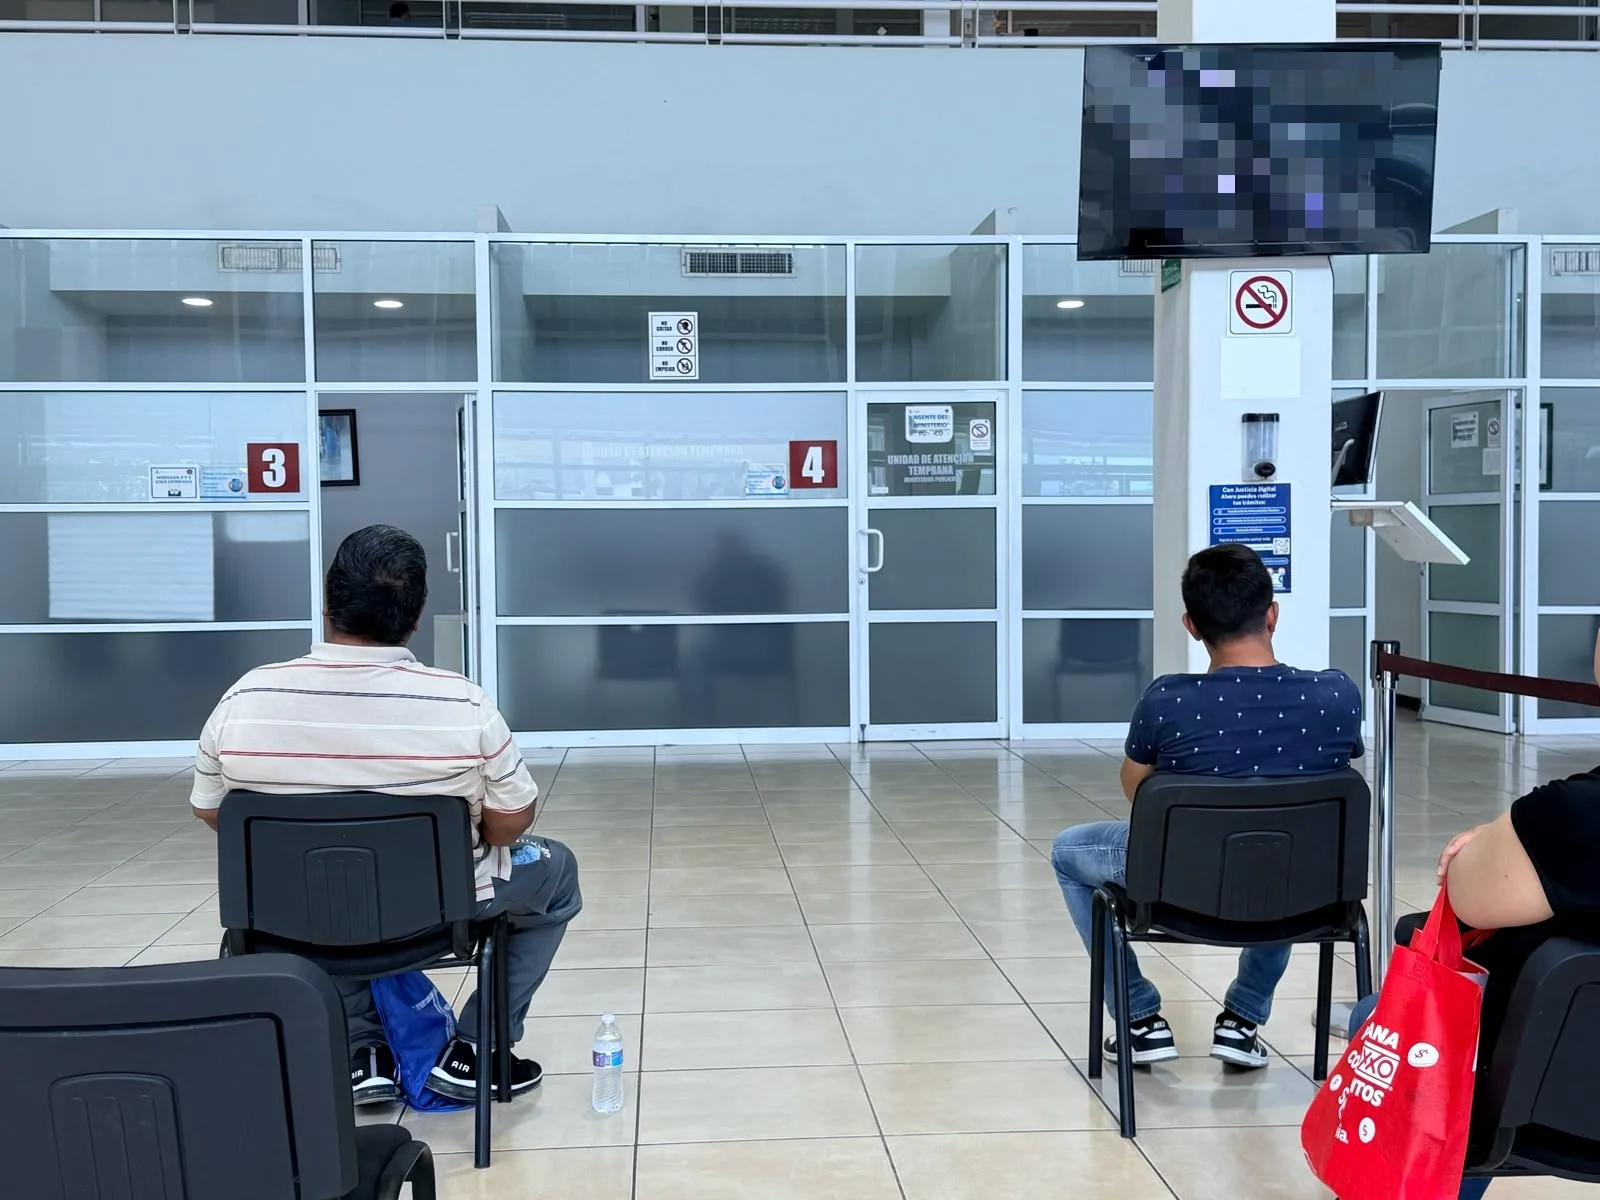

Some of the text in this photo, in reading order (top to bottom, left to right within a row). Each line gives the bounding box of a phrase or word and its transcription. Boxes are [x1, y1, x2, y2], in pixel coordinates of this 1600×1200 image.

[801, 446, 825, 483] 4
[888, 454, 920, 464] UNIDAD
[921, 454, 932, 464] DE
[262, 448, 286, 487] 3
[908, 466, 954, 476] TEMPRANA
[450, 1060, 470, 1073] AIR
